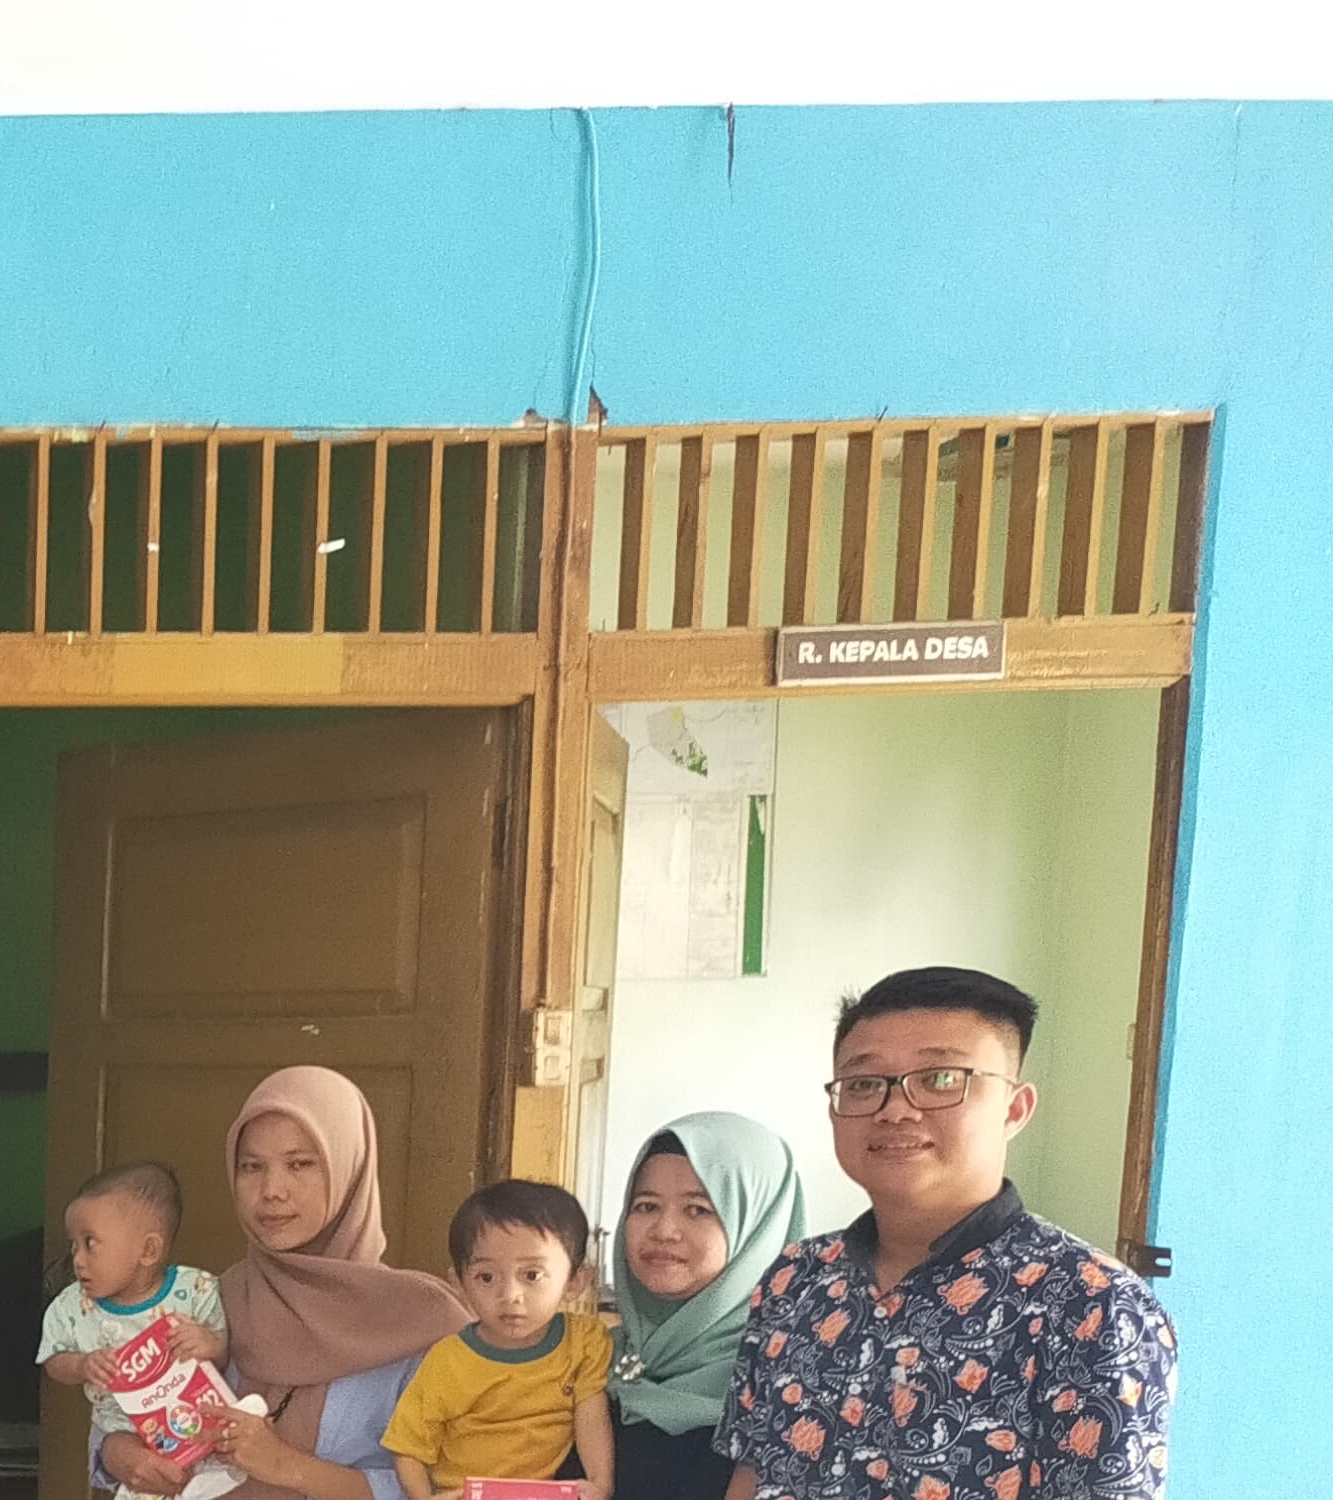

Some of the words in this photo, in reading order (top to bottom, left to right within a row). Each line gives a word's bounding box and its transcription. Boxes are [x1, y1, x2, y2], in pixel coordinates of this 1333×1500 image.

[798, 641, 823, 664] R.
[829, 639, 918, 663] KEPALA
[924, 636, 989, 660] DESA
[121, 1336, 162, 1383] SGM
